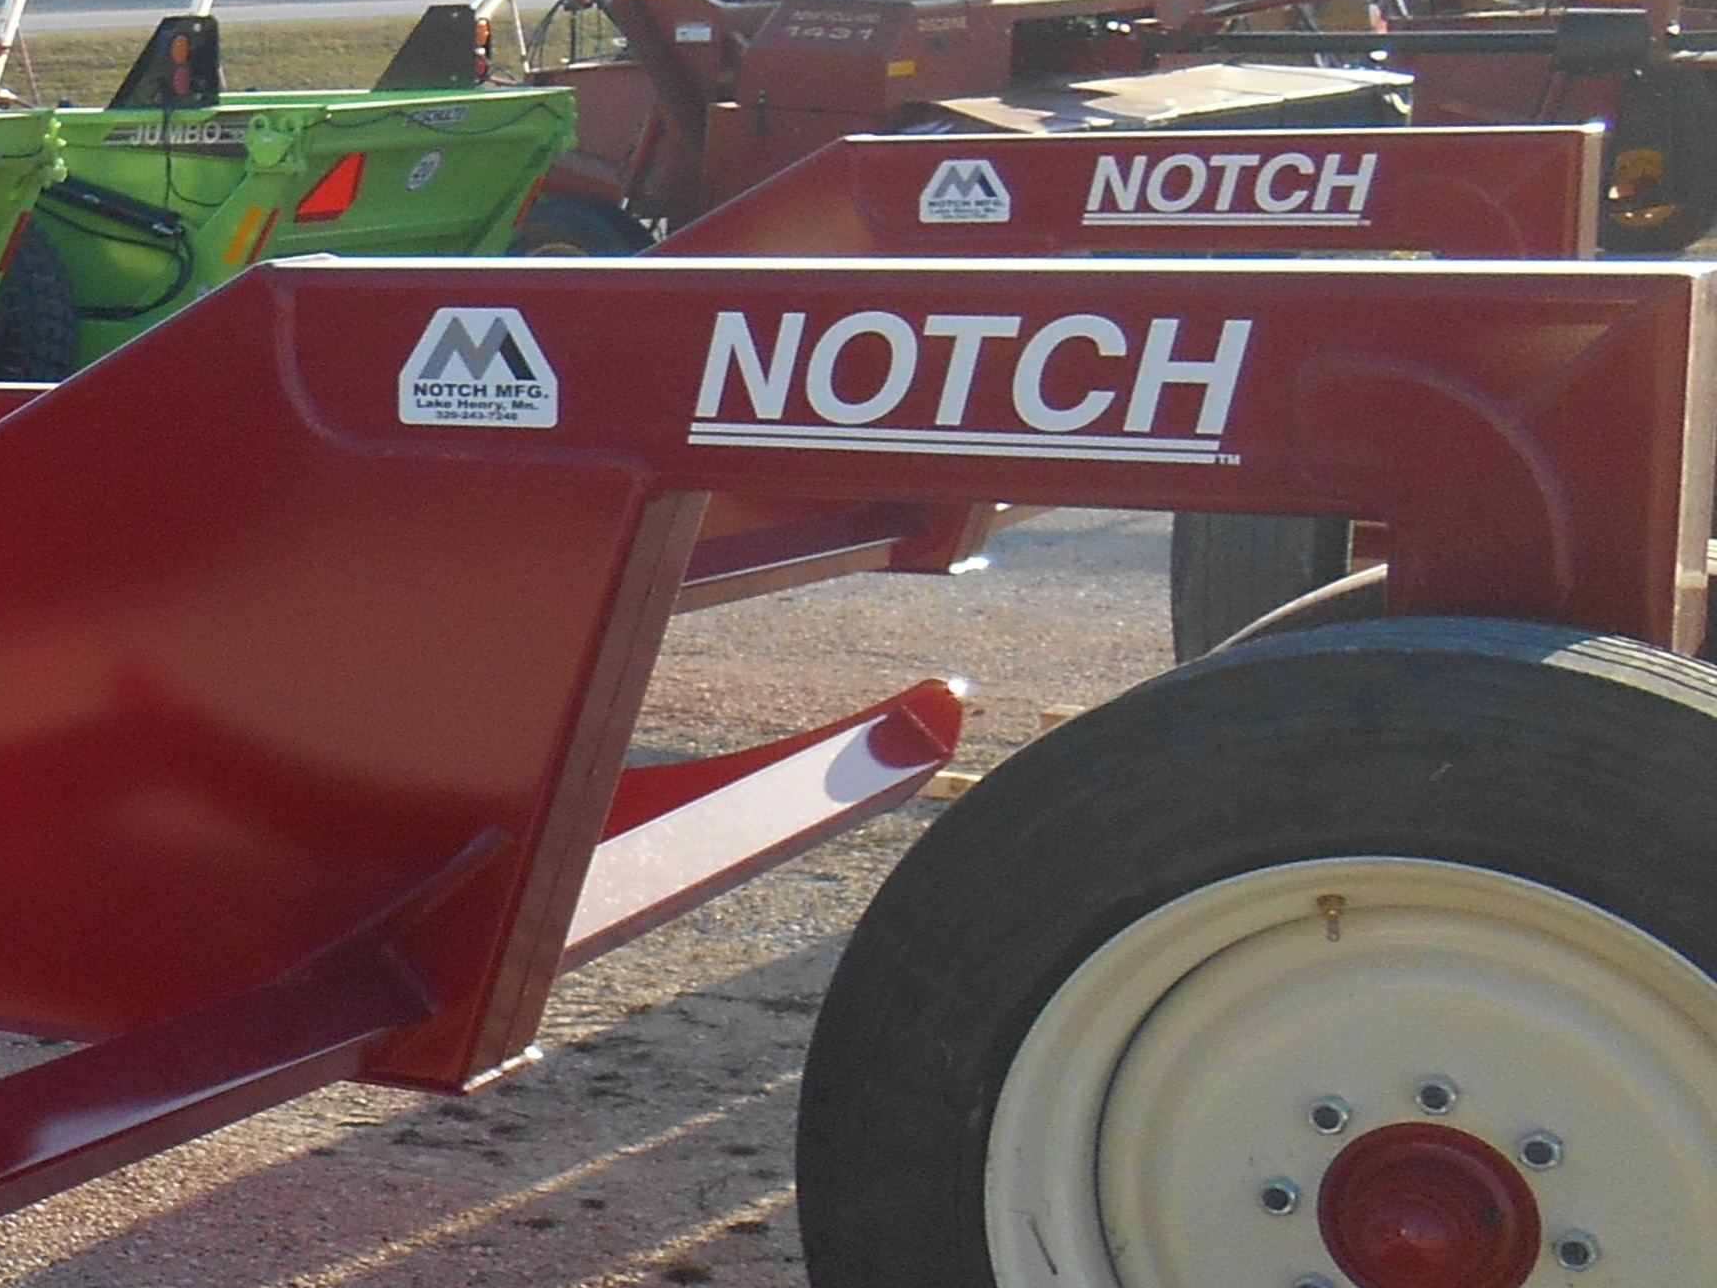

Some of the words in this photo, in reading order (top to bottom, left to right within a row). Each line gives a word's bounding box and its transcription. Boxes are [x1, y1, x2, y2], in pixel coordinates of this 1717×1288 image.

[131, 121, 222, 145] JUMBO
[1085, 152, 1378, 213] NOTCH
[694, 310, 1253, 435] NOTCH
[413, 383, 488, 397] NOTCH
[495, 384, 549, 399] MFG.
[416, 399, 452, 409] Lake
[457, 399, 507, 412] Henry,
